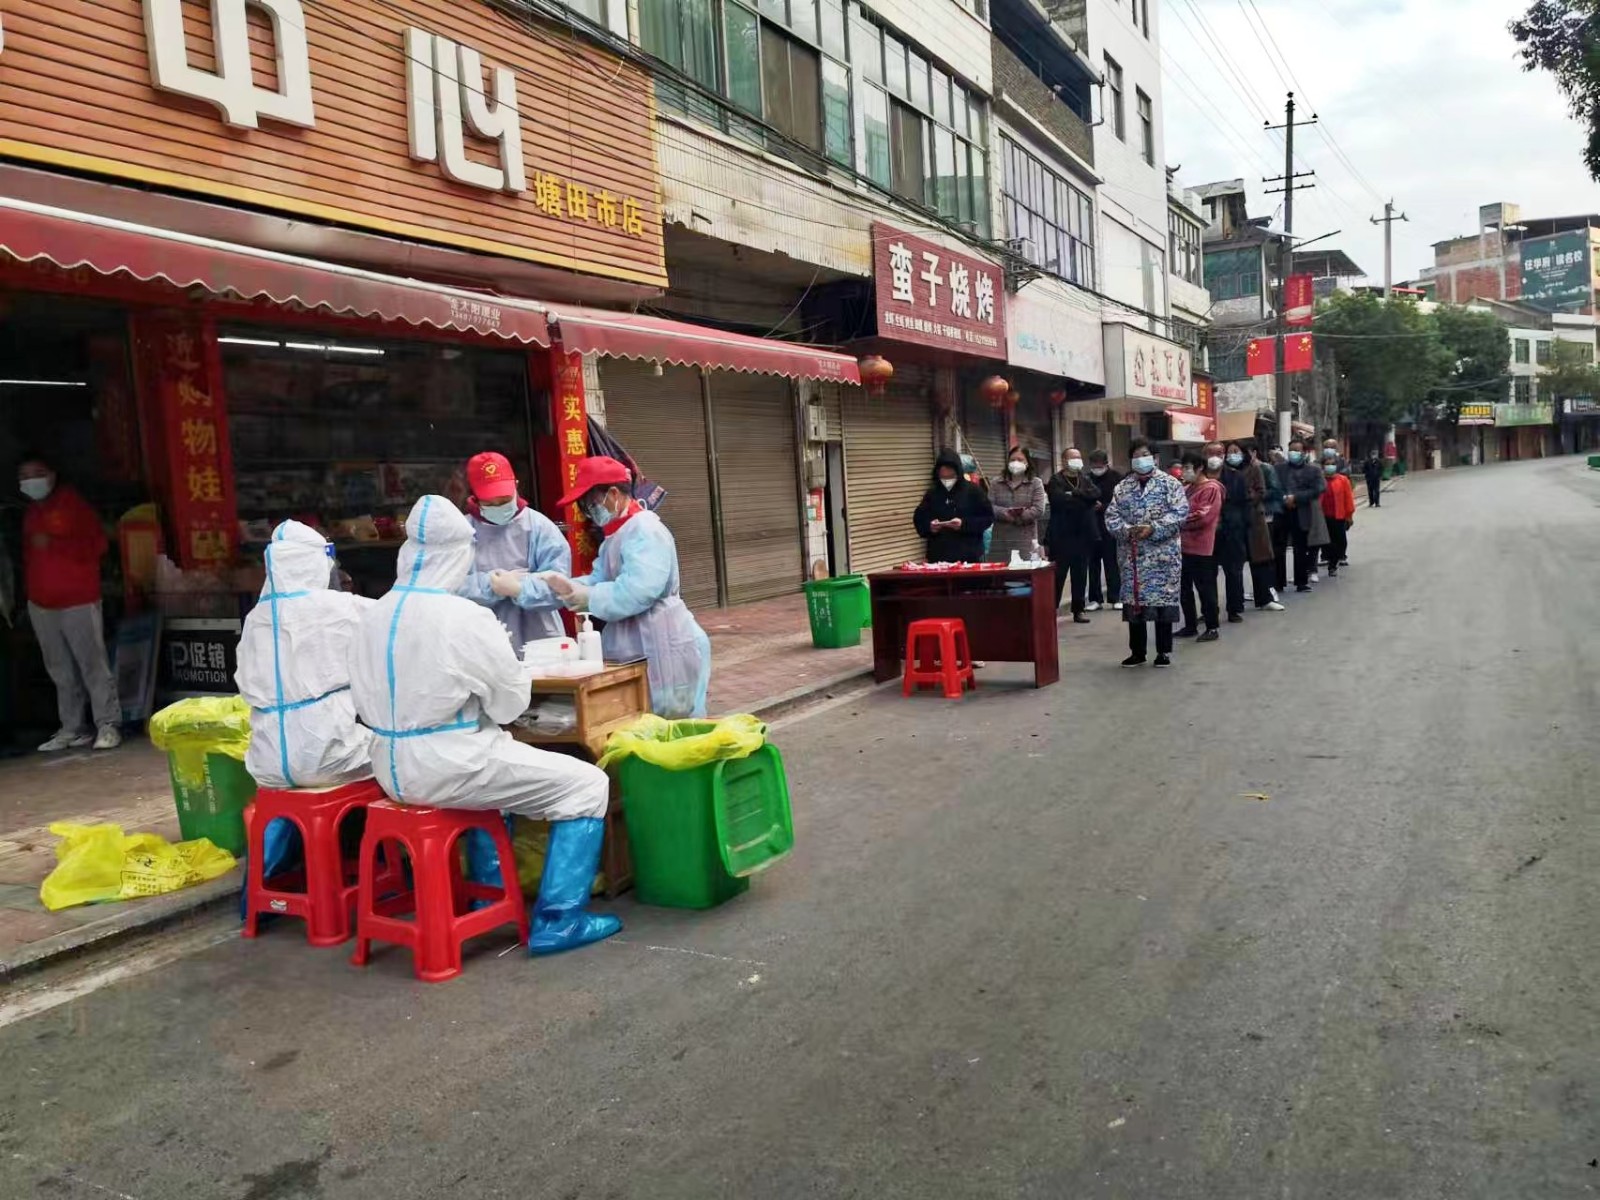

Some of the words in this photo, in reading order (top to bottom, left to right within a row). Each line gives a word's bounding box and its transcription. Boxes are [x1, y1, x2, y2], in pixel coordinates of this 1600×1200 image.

[534, 171, 643, 237] 塘田市店
[888, 242, 994, 325] 蛮子烧烤
